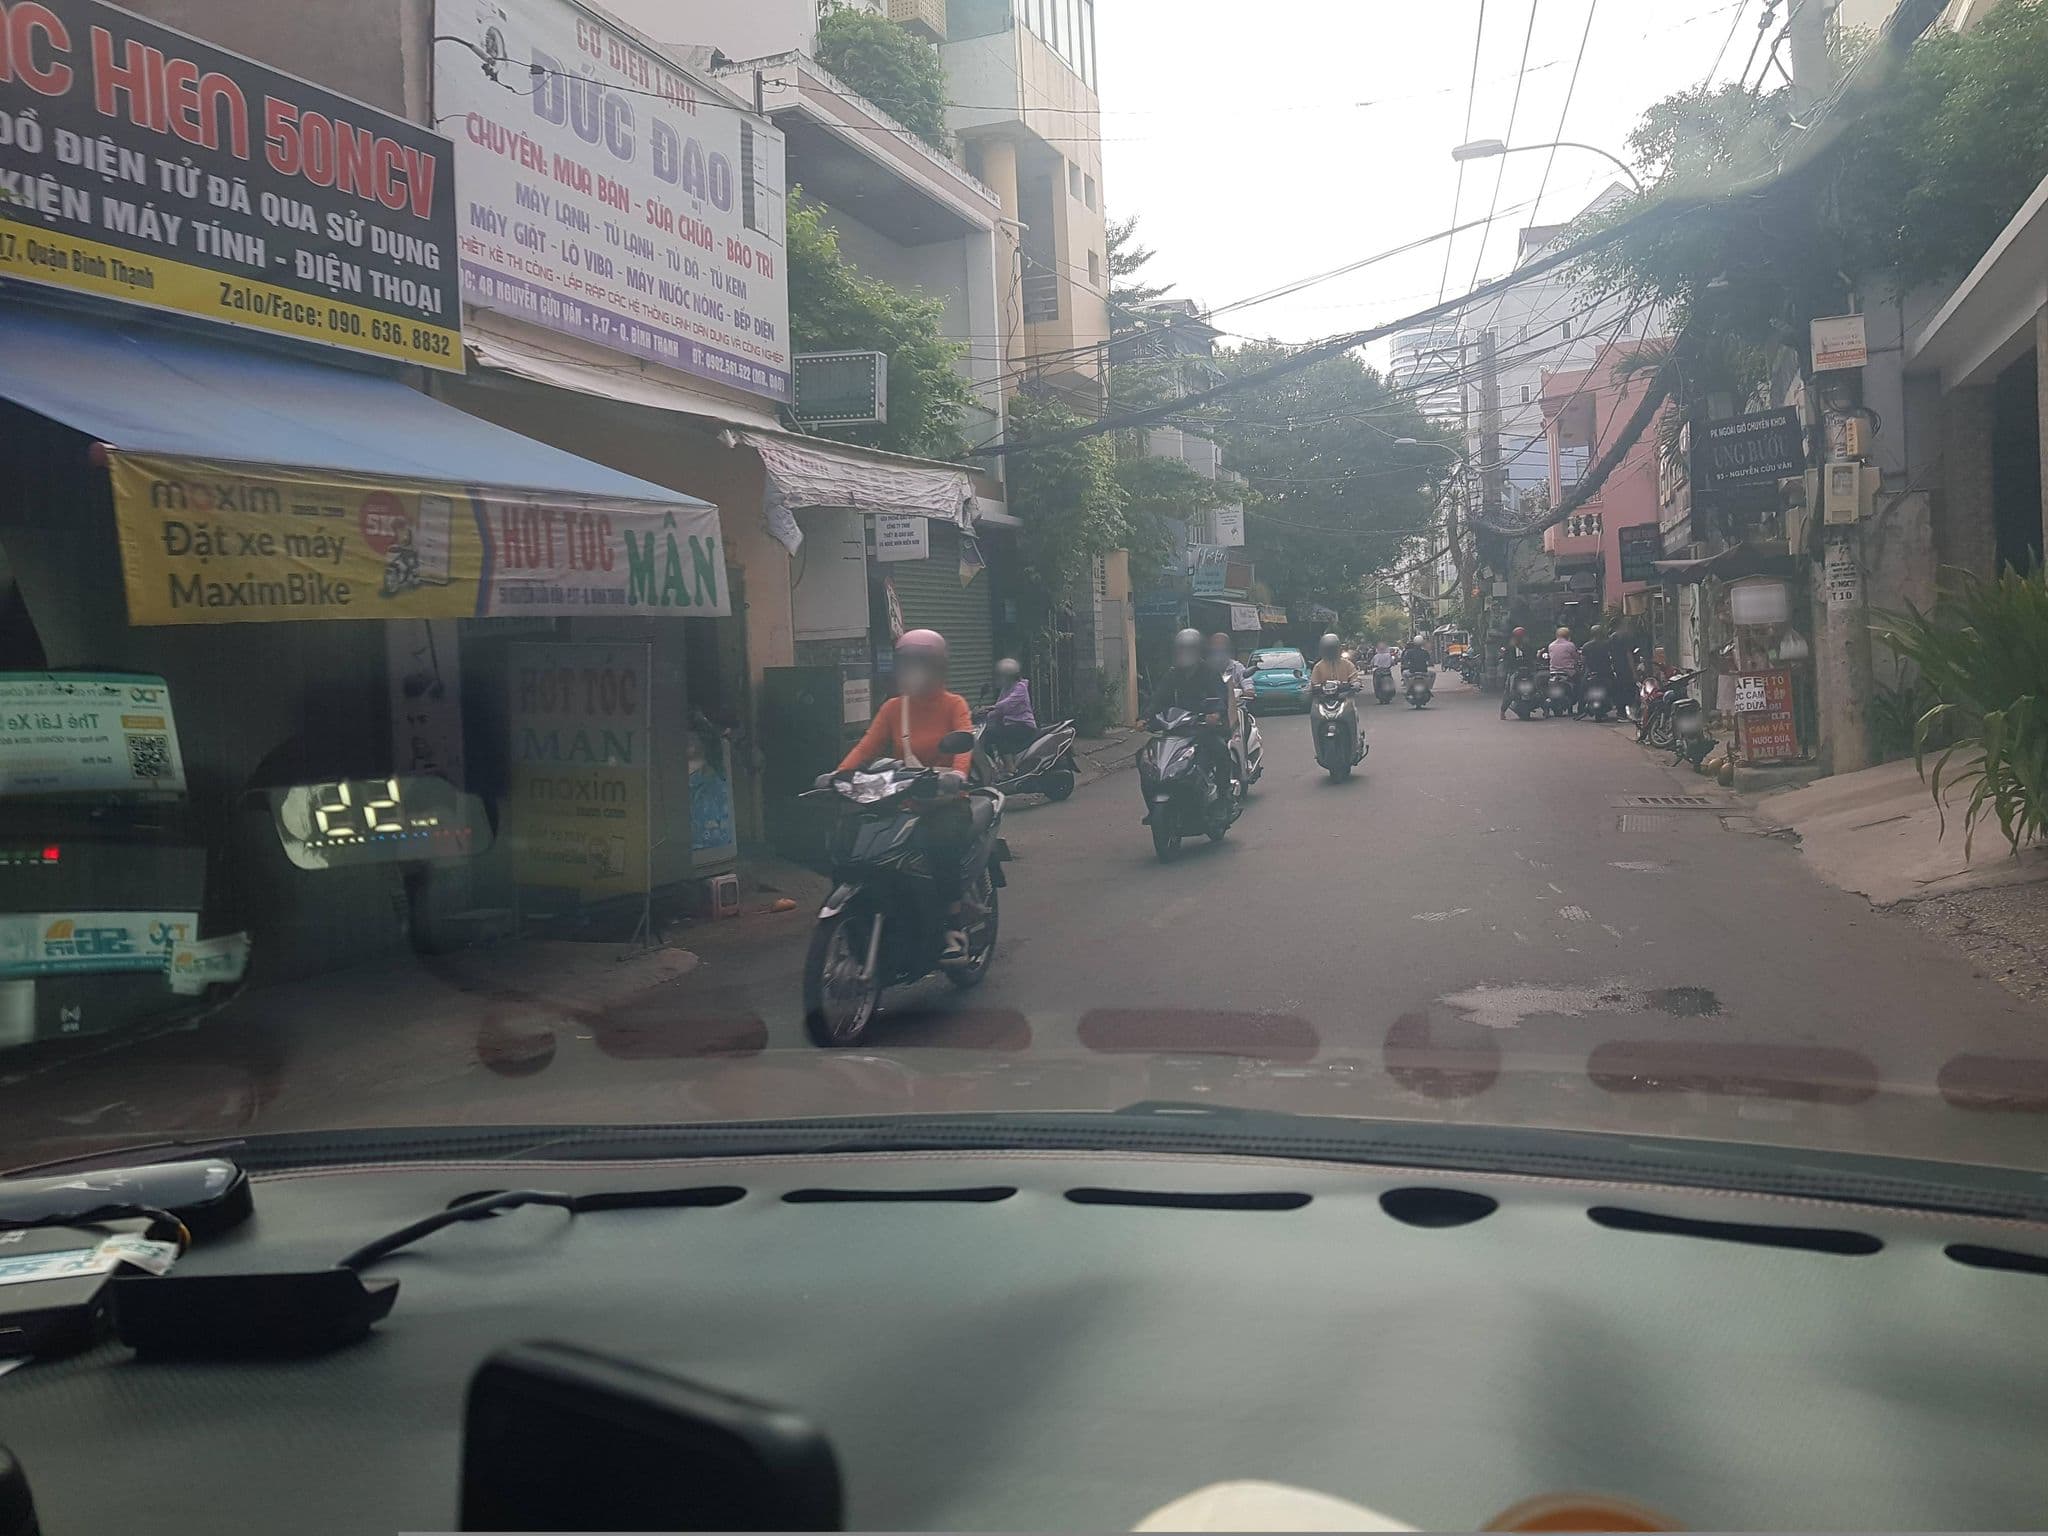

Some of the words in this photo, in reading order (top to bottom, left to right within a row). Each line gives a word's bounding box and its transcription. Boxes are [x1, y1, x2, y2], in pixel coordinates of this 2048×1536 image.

[264, 95, 436, 220] 50NCV
[531, 48, 636, 162] ĐỨC
[649, 117, 734, 213] ĐẠO
[54, 126, 146, 186] ĐIỆN
[155, 156, 201, 199] TỬ
[207, 174, 252, 216] ĐÃ
[261, 192, 319, 235] QUA
[325, 209, 365, 247] SỬ
[370, 225, 441, 271] DỤNG
[103, 197, 183, 246] MÁY
[192, 219, 266, 269] TÍNH
[295, 249, 362, 293] ĐIỆN
[369, 270, 442, 316] THOẠI
[516, 181, 550, 216] MÁY
[555, 199, 590, 234] LẠNH
[623, 229, 654, 262] LẠNH
[725, 274, 747, 300] KEM
[554, 153, 593, 197] MUA
[598, 174, 630, 213] BÁN
[726, 234, 752, 269] BẢO
[755, 250, 774, 280] TRÌ
[27, 238, 68, 272] Quận
[110, 258, 154, 290] Thạnh
[219, 282, 323, 327] Zalo/Face:
[413, 329, 450, 356] 8832
[470, 202, 507, 238] MÁY
[514, 222, 547, 255] GIẶT
[584, 248, 613, 280] VIBA
[626, 266, 655, 296] MÁY
[658, 279, 690, 310] NƯỚC
[693, 292, 724, 322] NÓNG
[734, 306, 751, 332] BẾP
[754, 316, 775, 343] ĐIỆN
[1729, 465, 1760, 478] NGUYỄN
[160, 520, 228, 564] Đặt
[236, 531, 276, 557] xe
[283, 526, 347, 564] máy
[168, 572, 353, 609] MaximBike
[623, 510, 719, 608] MÂN
